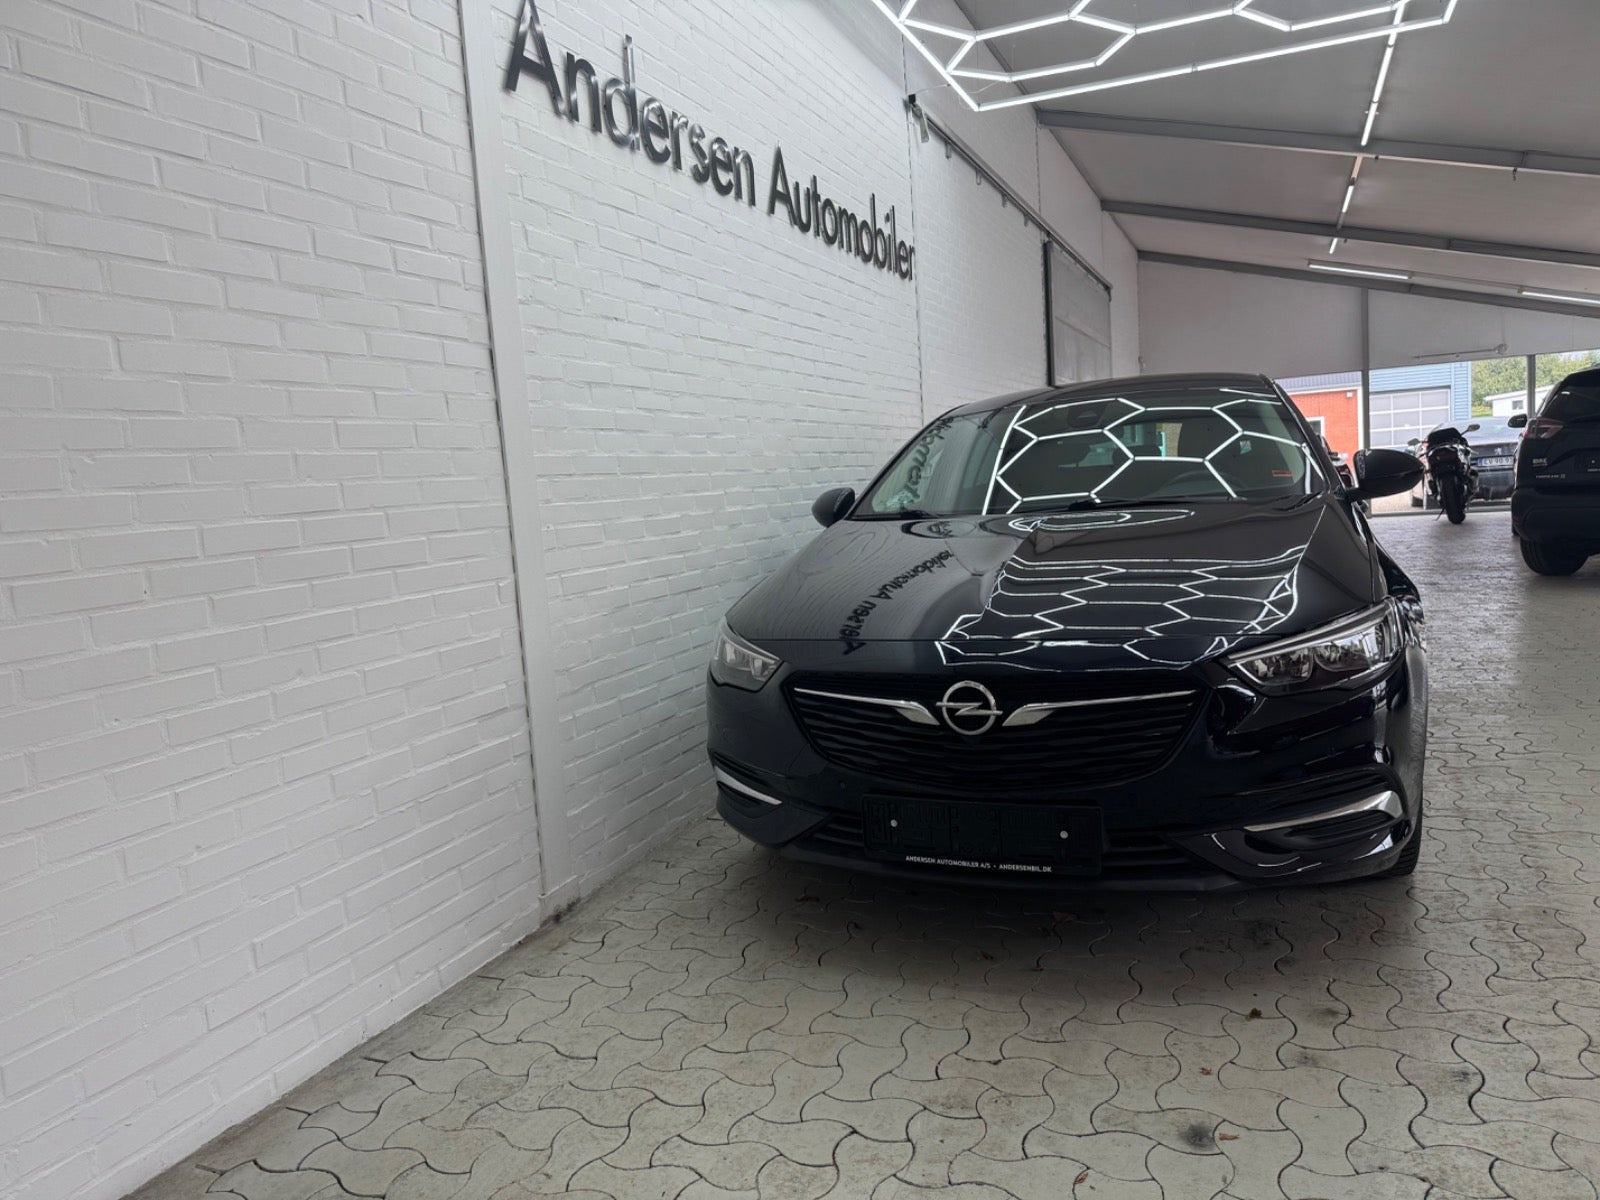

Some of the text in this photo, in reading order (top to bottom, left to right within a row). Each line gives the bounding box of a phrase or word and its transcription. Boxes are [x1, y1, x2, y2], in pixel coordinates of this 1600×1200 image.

[505, 0, 916, 281] Andersen Automobiler
[905, 855, 936, 864] ANDERSEN
[936, 858, 979, 868] AUTOMOBILER
